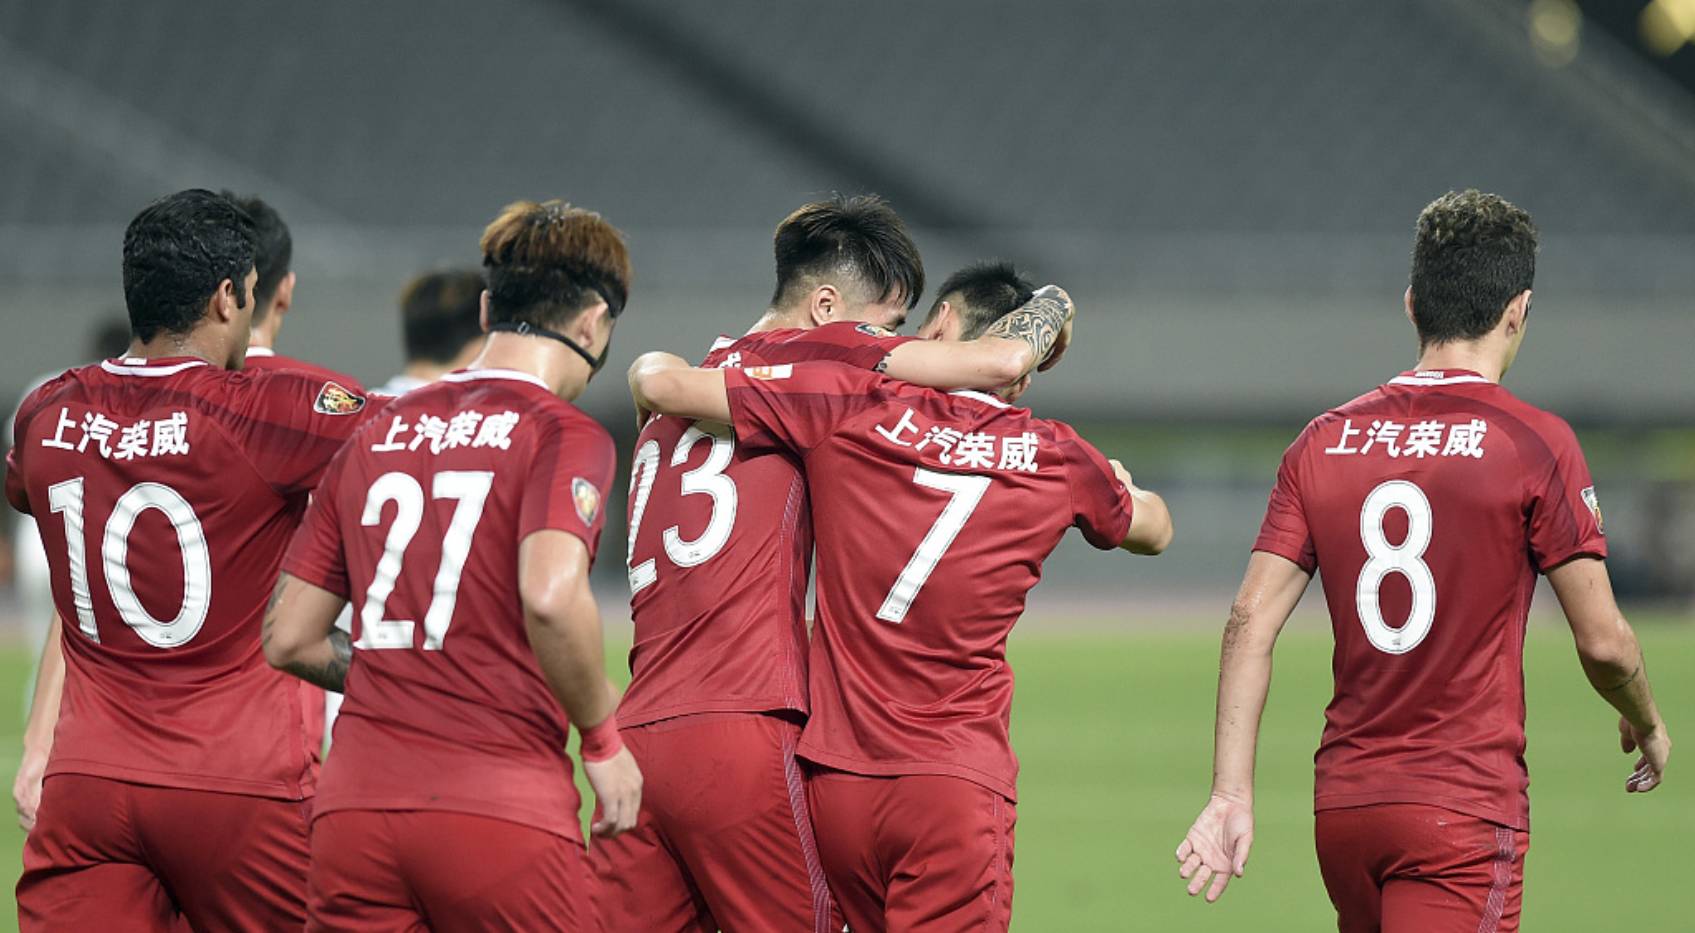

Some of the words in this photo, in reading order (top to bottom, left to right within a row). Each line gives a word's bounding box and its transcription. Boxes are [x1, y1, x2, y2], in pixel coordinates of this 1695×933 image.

[42, 408, 190, 460] 上汽荣威
[371, 411, 520, 455] 上汽荣威
[627, 421, 738, 595] 23
[874, 408, 1041, 473] 上汽荣威
[1325, 418, 1488, 459] 上汽荣威
[48, 476, 212, 649] 10
[353, 470, 495, 651] 27
[876, 465, 993, 624] 7
[1356, 480, 1437, 655] 8
